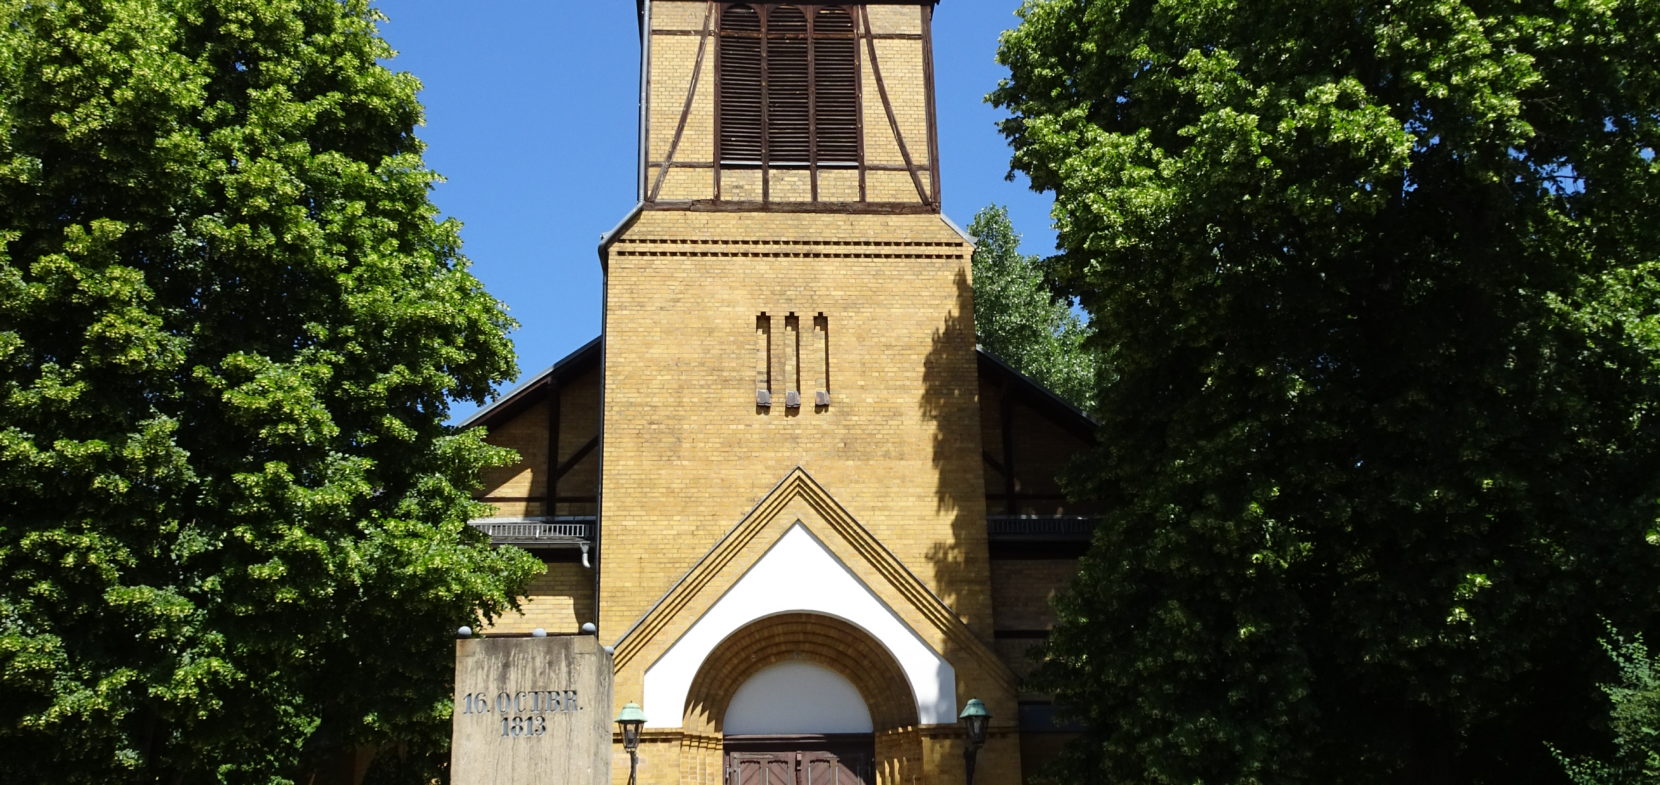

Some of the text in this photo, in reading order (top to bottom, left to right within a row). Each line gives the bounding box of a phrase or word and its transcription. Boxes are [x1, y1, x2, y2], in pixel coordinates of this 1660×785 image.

[463, 689, 584, 715] 16. OCTBR.
[501, 715, 546, 737] 1813
